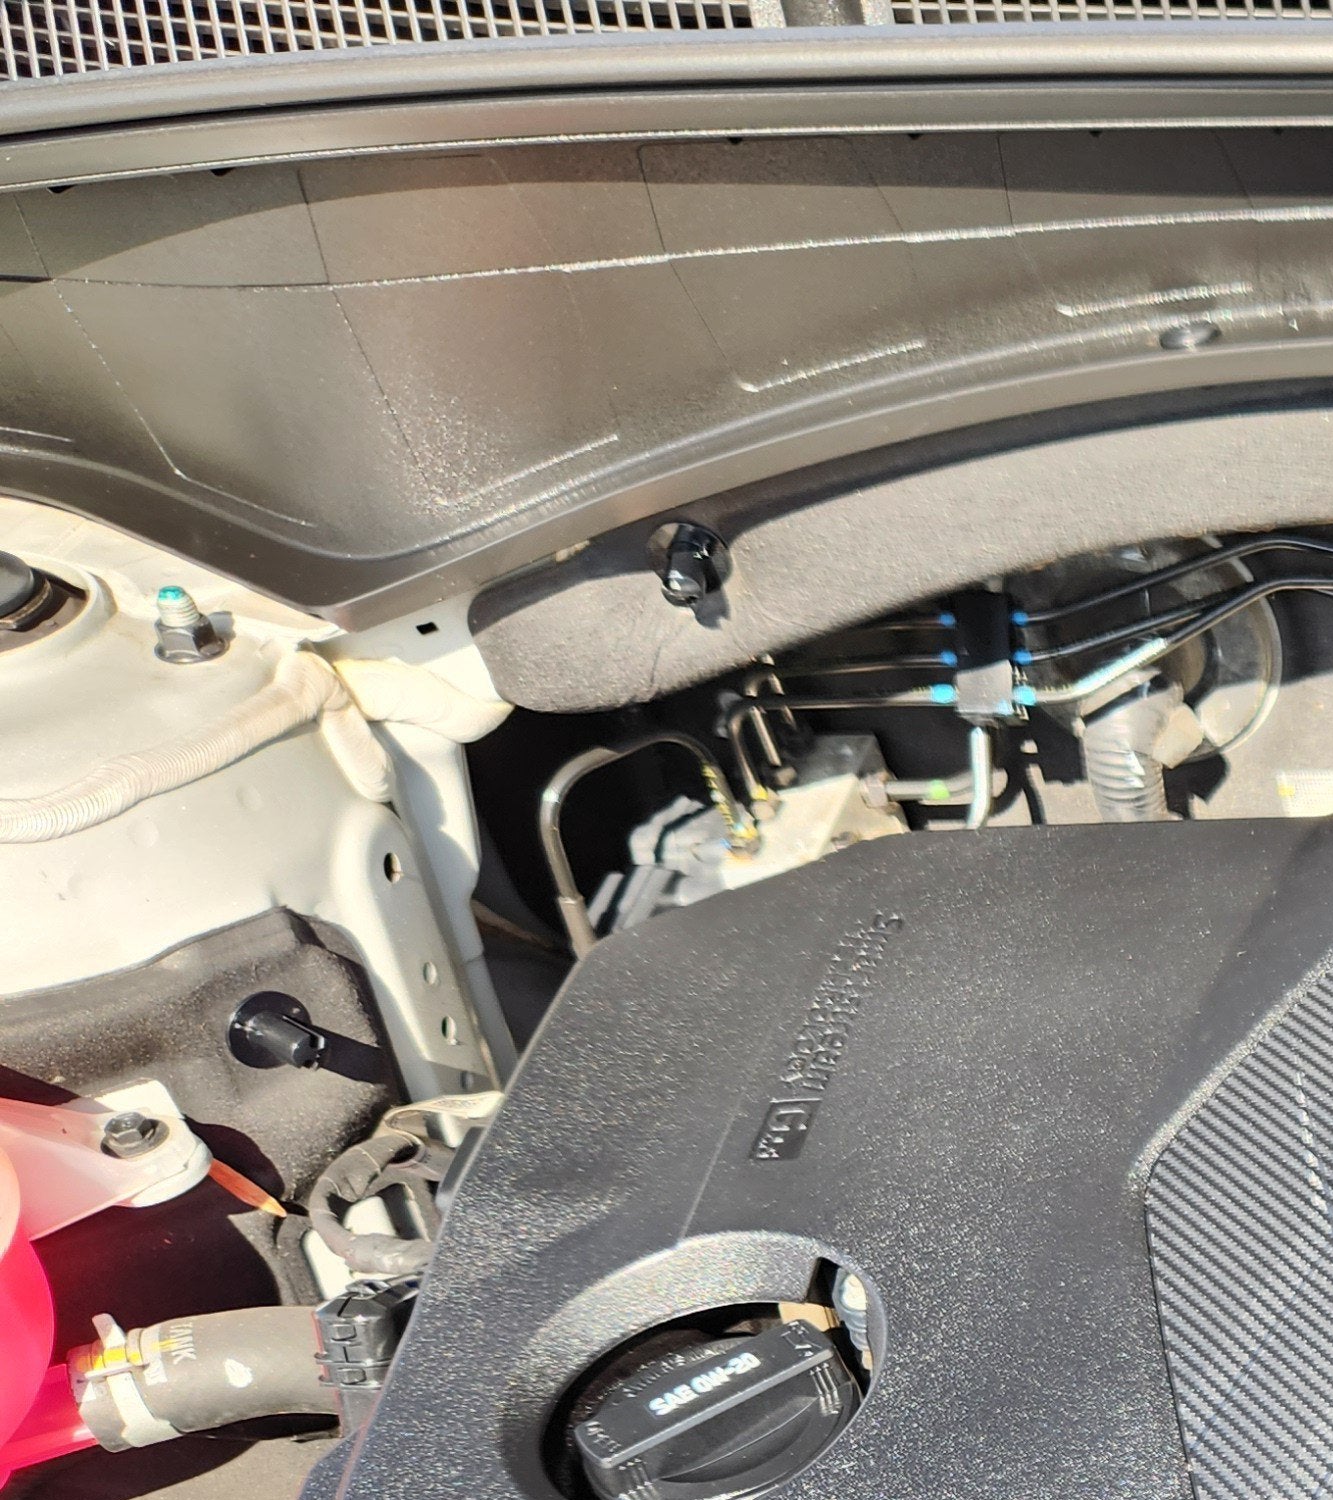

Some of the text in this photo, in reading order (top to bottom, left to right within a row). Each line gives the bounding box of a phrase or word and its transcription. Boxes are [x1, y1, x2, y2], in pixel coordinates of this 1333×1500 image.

[169, 1321, 197, 1365] TANK
[648, 1384, 700, 1416] SAE
[690, 1352, 761, 1393] 0W-20
